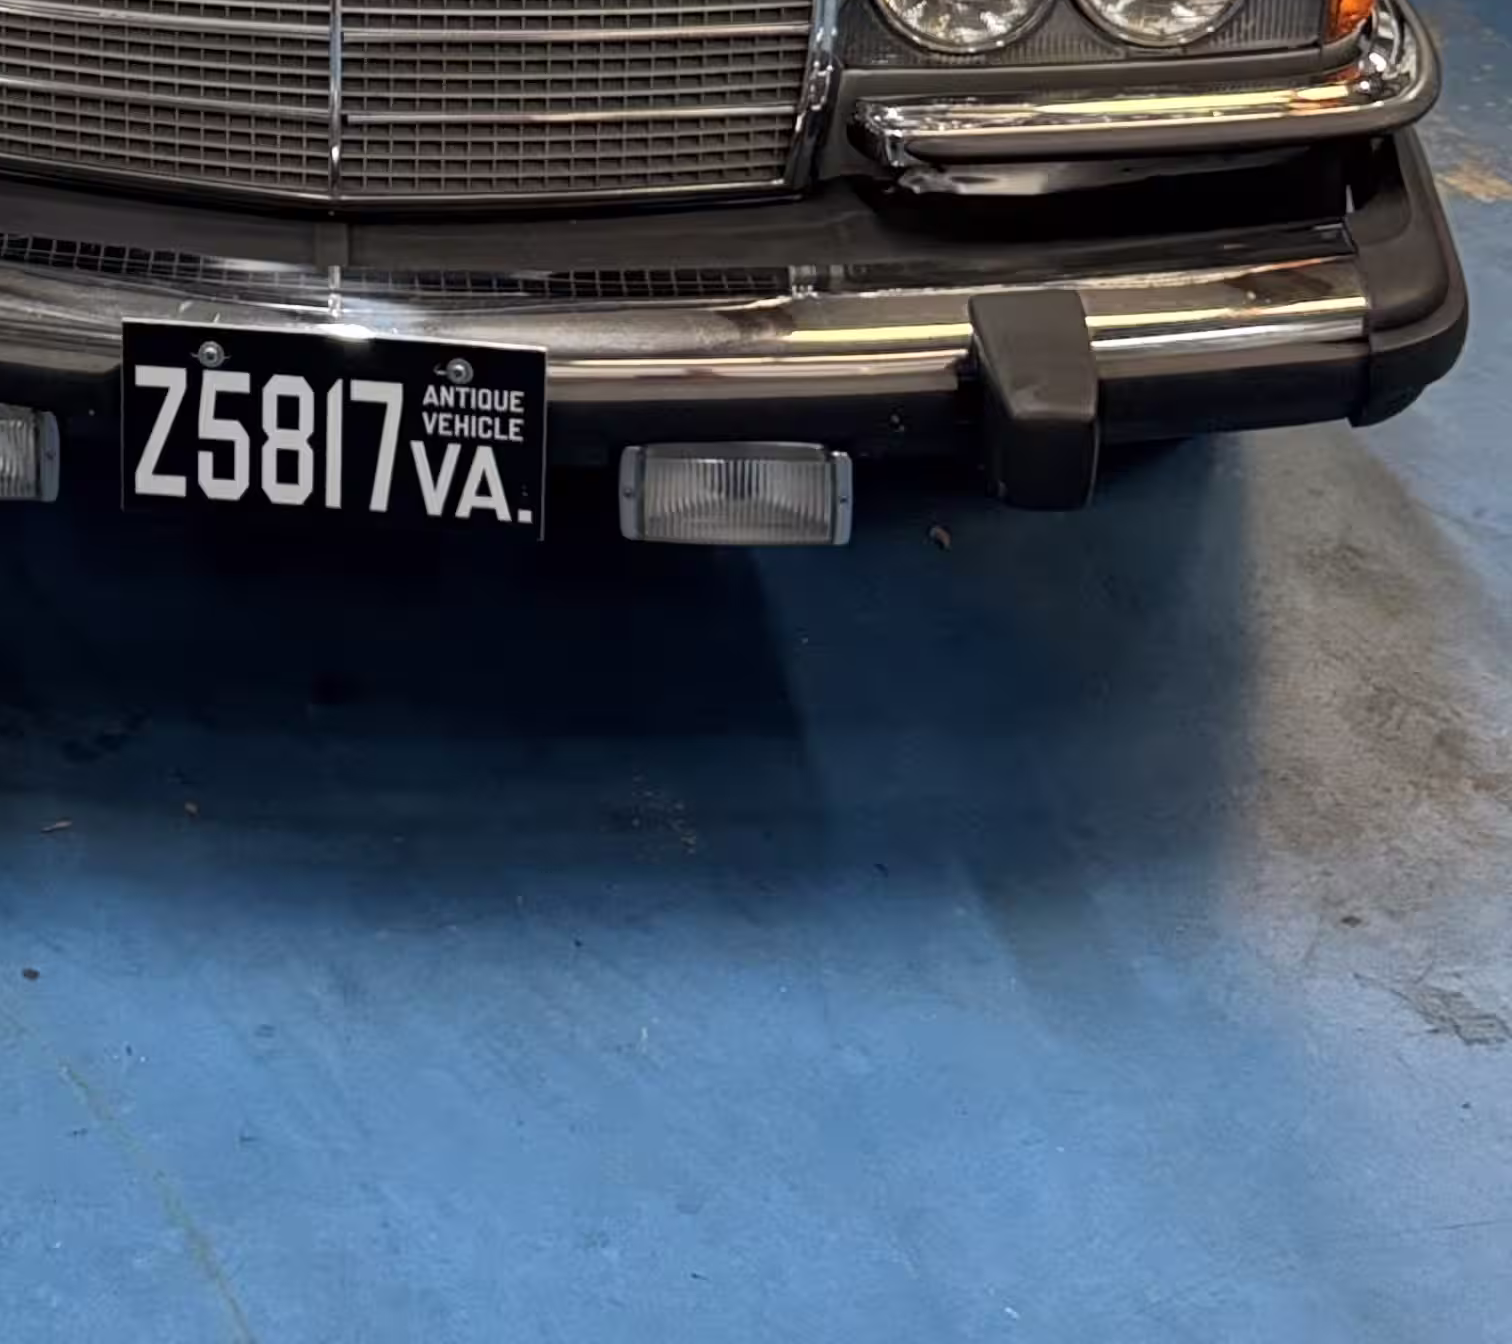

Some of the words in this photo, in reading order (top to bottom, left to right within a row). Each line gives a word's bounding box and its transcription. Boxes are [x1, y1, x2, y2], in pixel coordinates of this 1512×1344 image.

[421, 411, 525, 442] VEHICLE
[422, 384, 525, 413] ANTIQUE
[135, 365, 403, 512] Z5817
[410, 439, 532, 523] VA.
